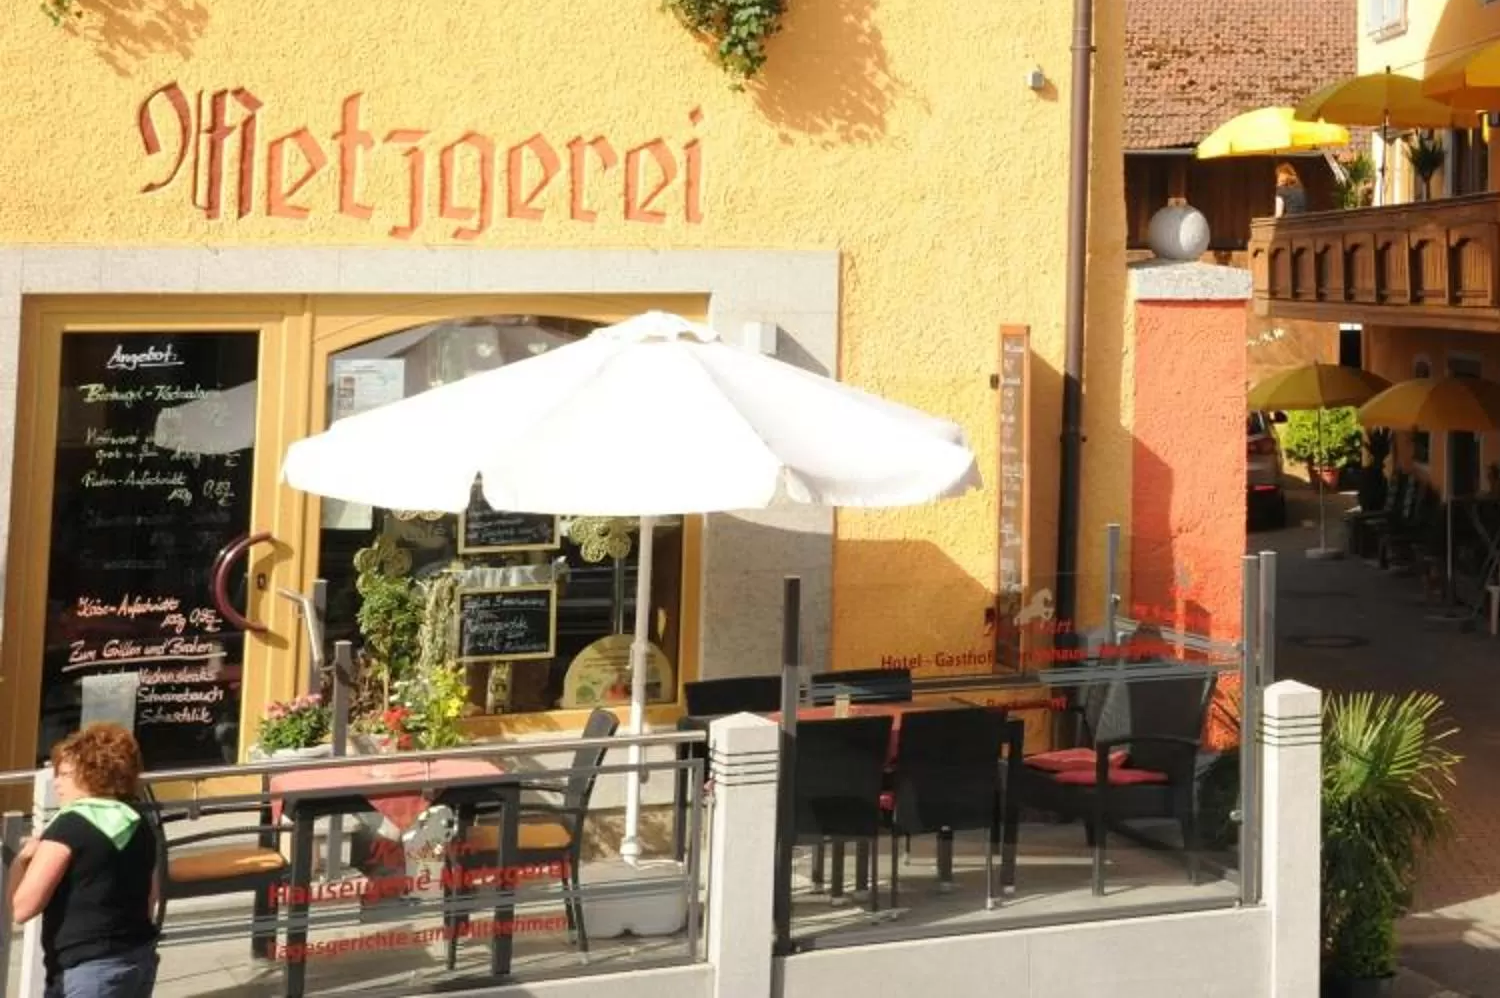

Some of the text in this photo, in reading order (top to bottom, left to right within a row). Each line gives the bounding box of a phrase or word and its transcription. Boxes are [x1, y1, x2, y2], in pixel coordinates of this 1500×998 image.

[137, 80, 705, 242] Metzgerei
[881, 652, 922, 670] Hotel
[935, 649, 994, 668] Gasthof
